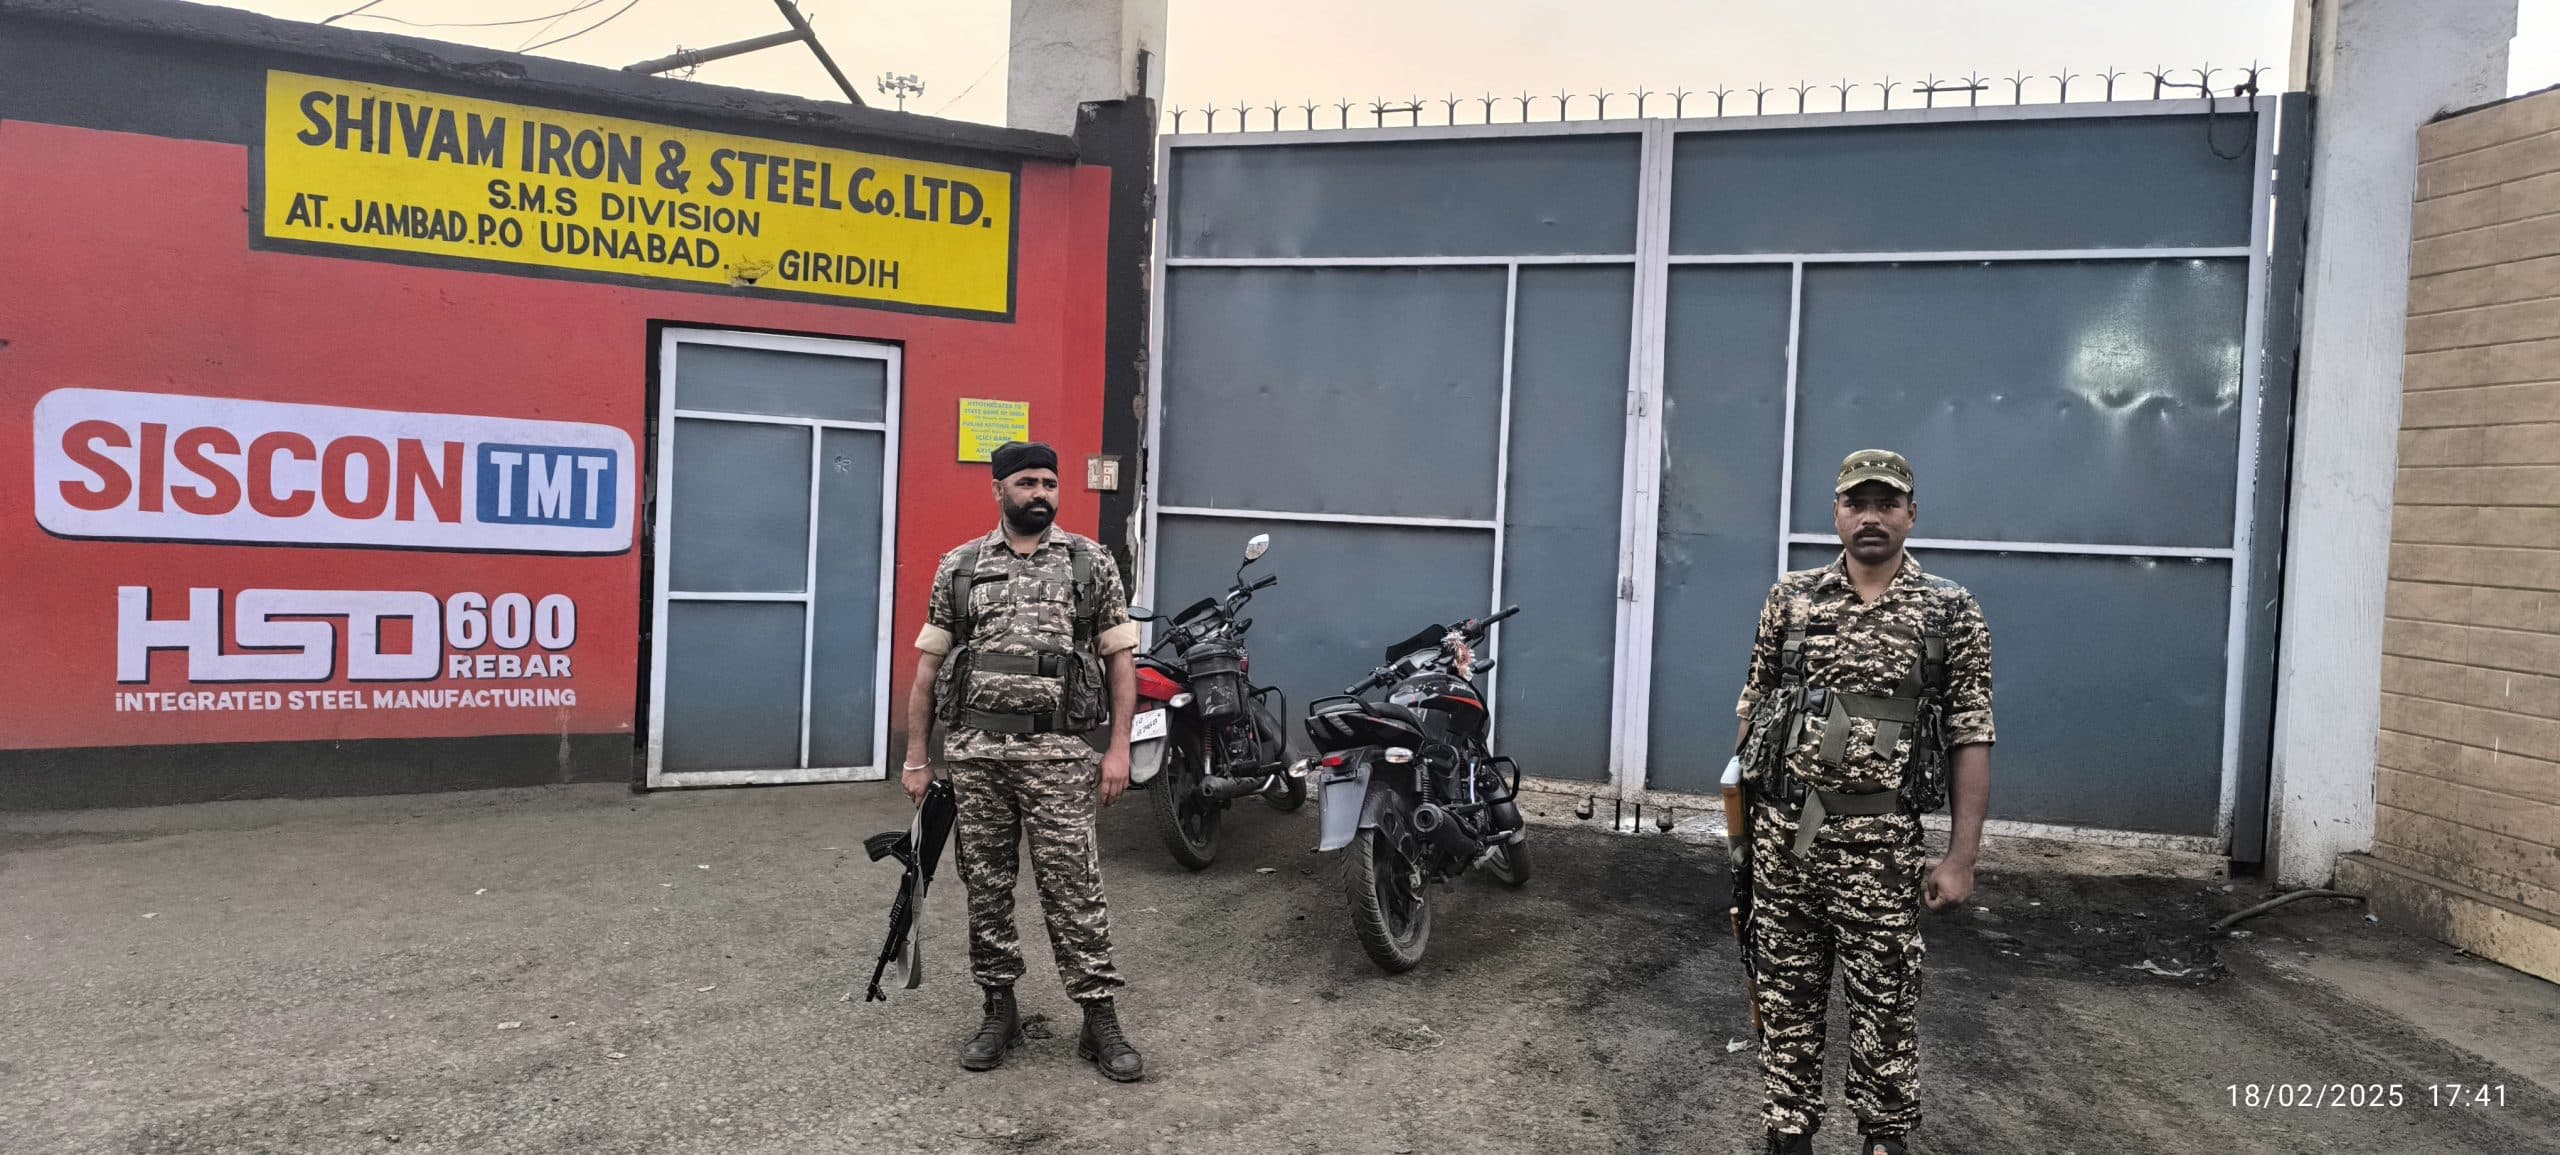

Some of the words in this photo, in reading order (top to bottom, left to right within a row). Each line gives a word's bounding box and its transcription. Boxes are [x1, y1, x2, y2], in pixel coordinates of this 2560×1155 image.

[296, 90, 507, 169] SHIVAM
[521, 120, 643, 186] IRON
[654, 139, 692, 196] &
[706, 148, 842, 211] STEEL
[487, 179, 578, 217] S.M.S
[601, 192, 761, 238] DIVISION
[540, 220, 730, 270] UDNABAD.
[778, 249, 900, 290] GIRIDIH
[58, 419, 465, 524] SISCON
[490, 450, 609, 521] TMT
[117, 586, 441, 684] HSD
[446, 591, 577, 650] 600
[449, 654, 573, 679] REBAR
[288, 689, 368, 711] STEEL
[373, 688, 577, 709] MANUFACTURING
